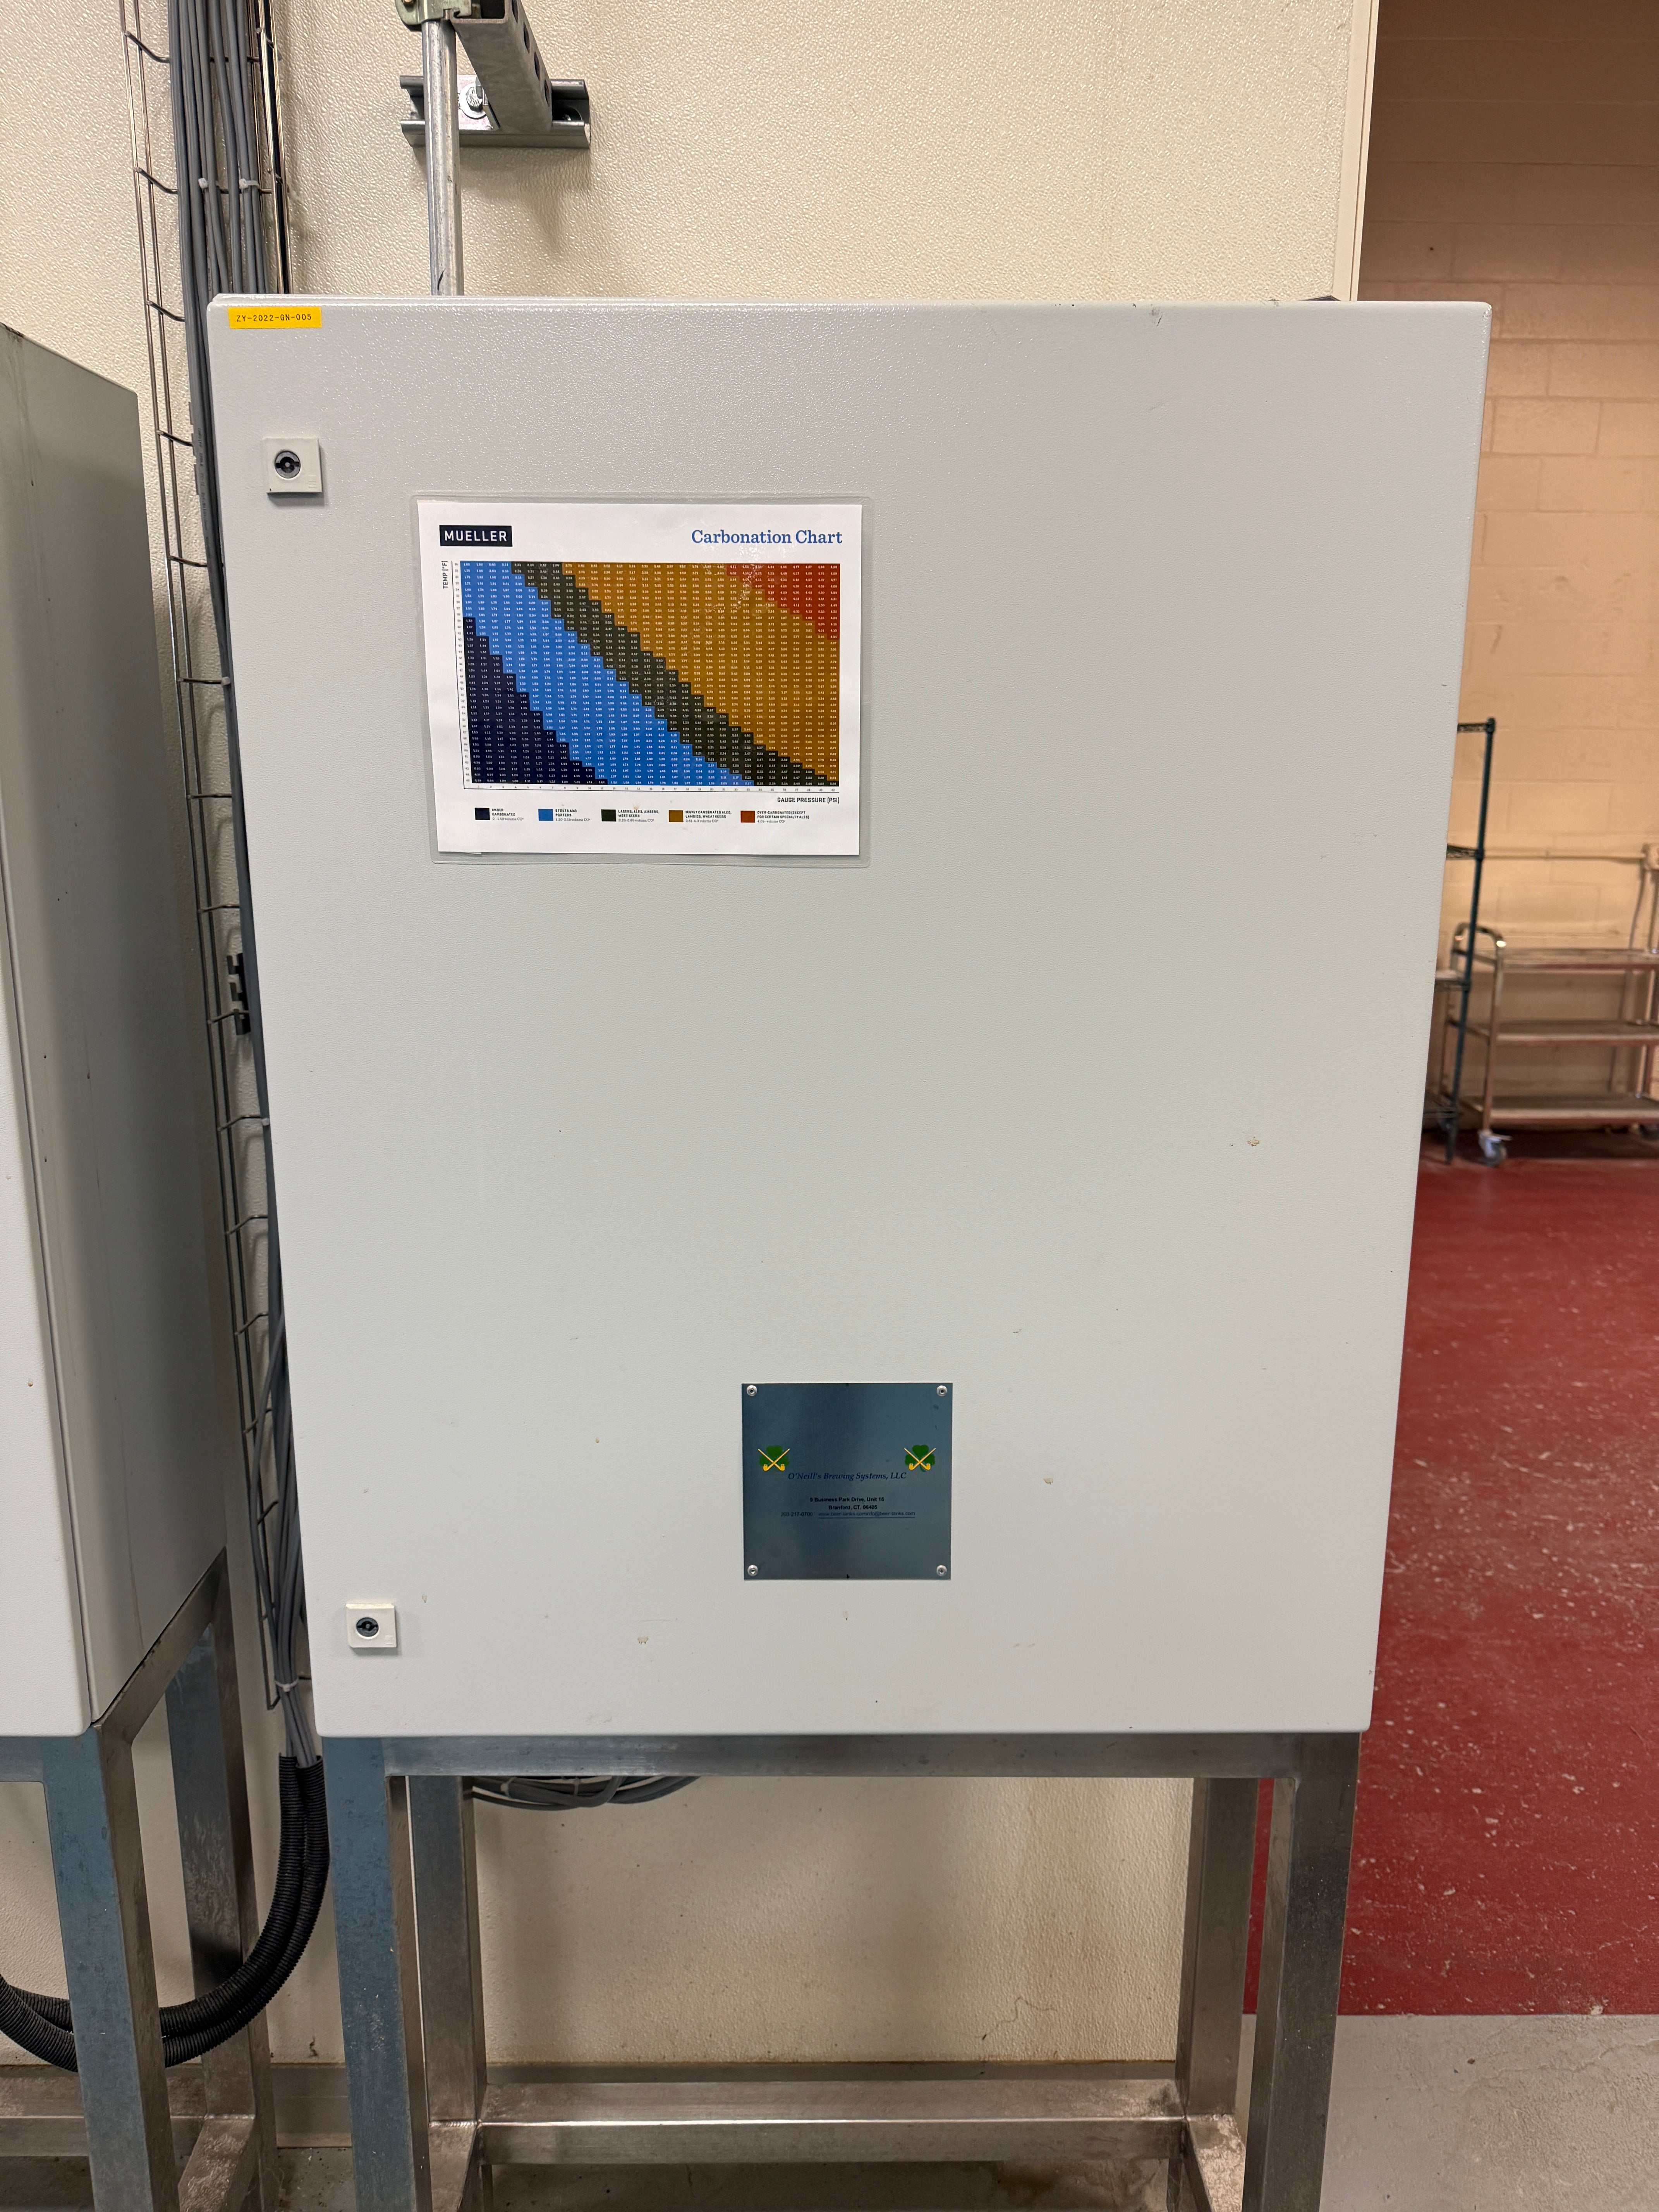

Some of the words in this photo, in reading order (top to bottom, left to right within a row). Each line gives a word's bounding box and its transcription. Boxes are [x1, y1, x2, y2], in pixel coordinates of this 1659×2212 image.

[237, 314, 311, 322] ZY-2022-GN-005
[444, 530, 507, 541] MUELLER
[691, 529, 792, 544] Carbonation
[795, 529, 843, 544] Chart
[824, 1473, 855, 1481] Brewing
[856, 1472, 888, 1481] Systems,
